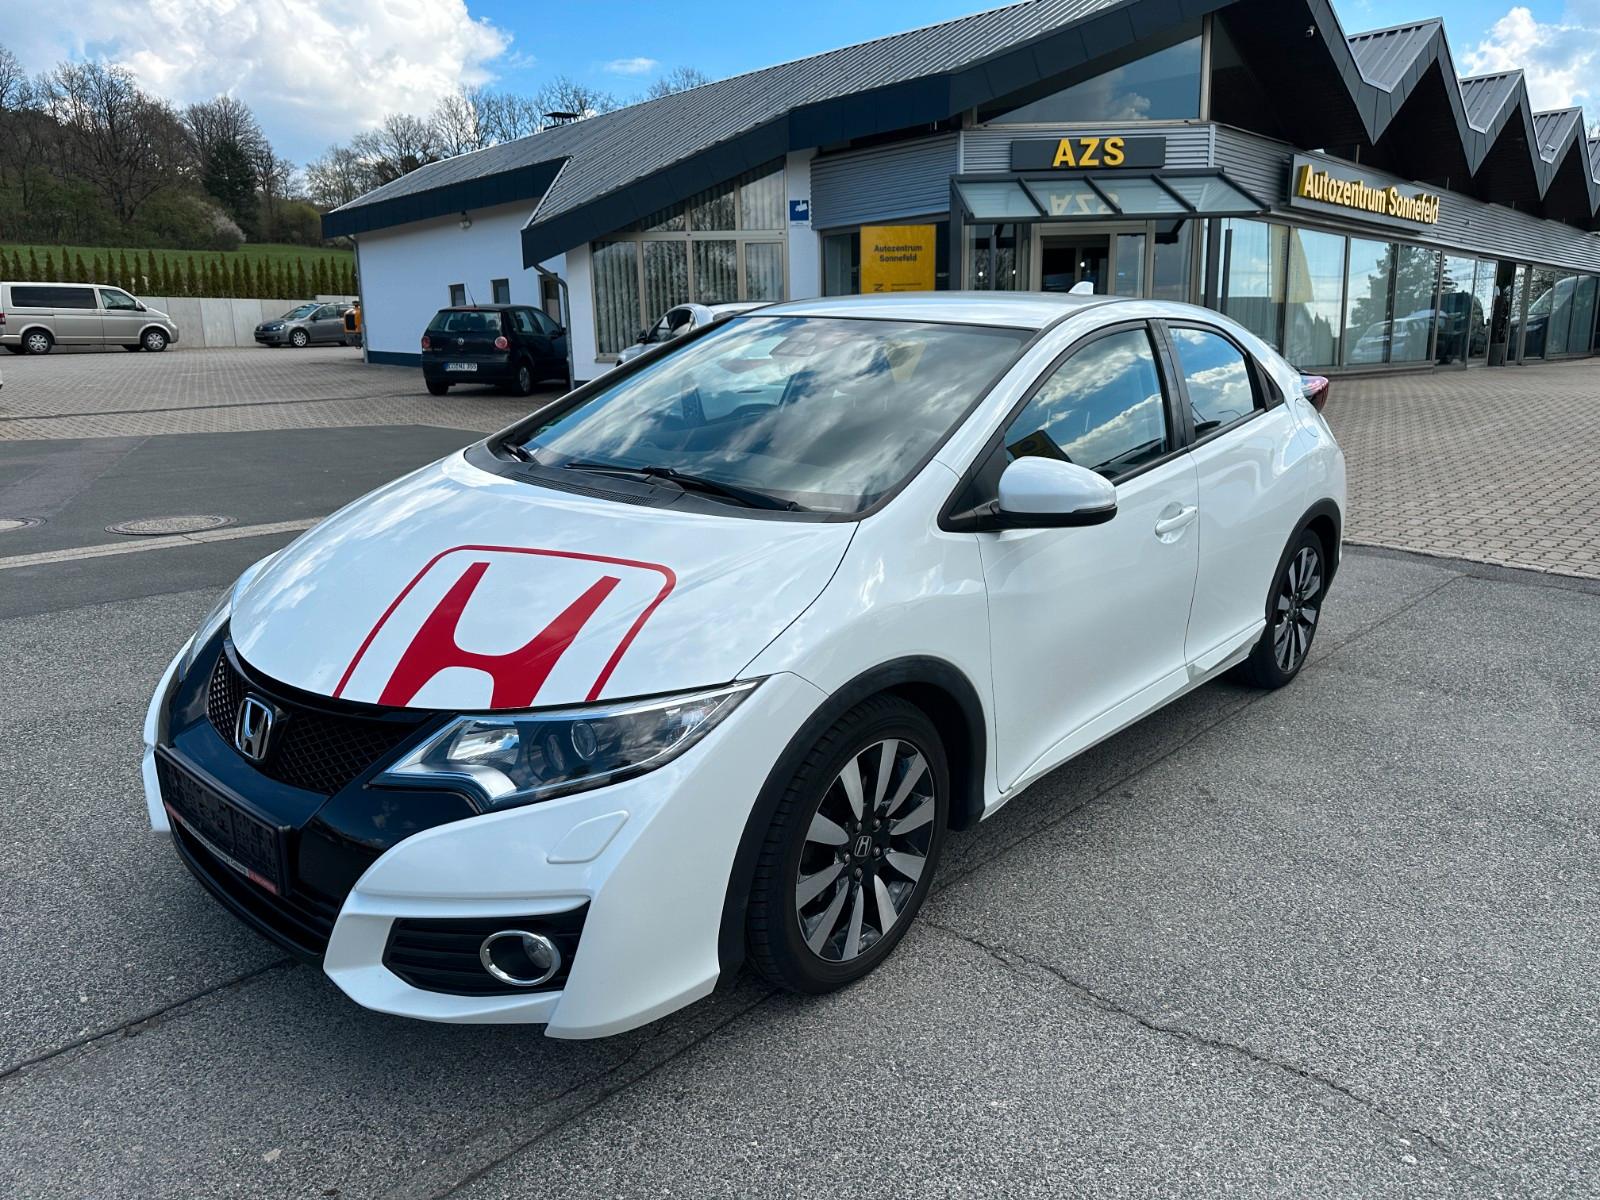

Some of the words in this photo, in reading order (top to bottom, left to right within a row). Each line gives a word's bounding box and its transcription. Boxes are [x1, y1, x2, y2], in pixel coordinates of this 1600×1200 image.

[1052, 137, 1125, 167] AZS
[1300, 164, 1387, 213] Autozentrum
[1388, 186, 1440, 225] Sonnefeld
[873, 244, 923, 252] Autozentrum
[879, 253, 918, 263] Sonnefeld
